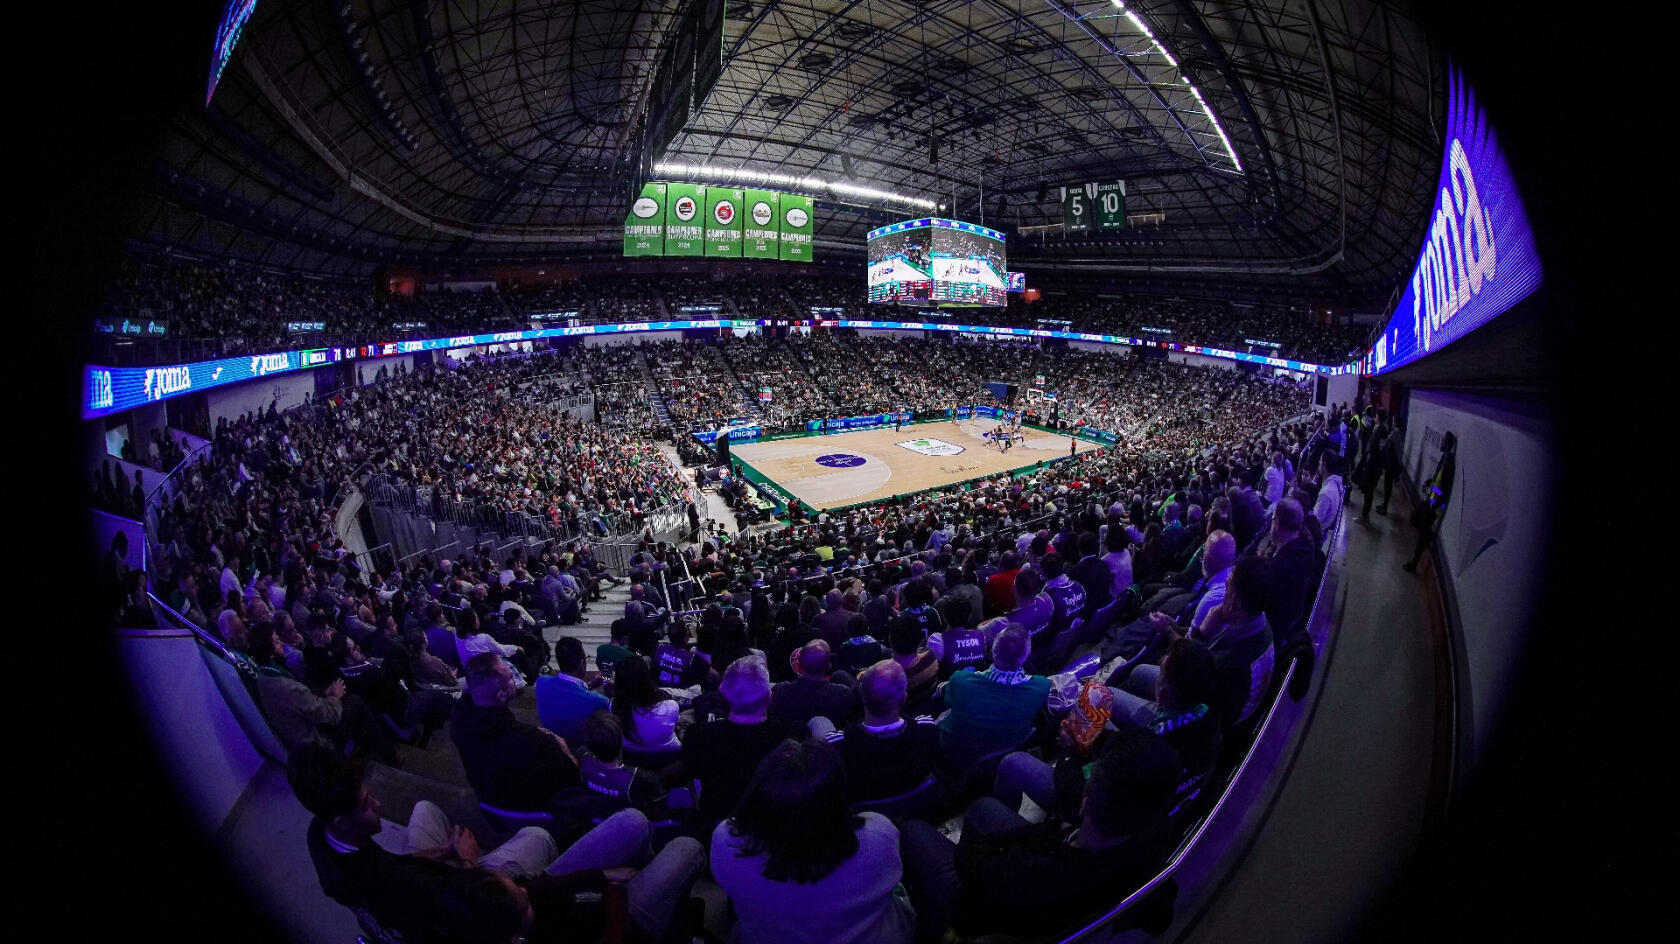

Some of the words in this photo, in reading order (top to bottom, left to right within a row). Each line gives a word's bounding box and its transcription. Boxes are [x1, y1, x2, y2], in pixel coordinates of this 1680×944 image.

[1072, 196, 1083, 216] 5
[1101, 193, 1119, 213] 10
[729, 429, 757, 439] Unicaja
[1062, 592, 1083, 606] Taylor
[955, 638, 980, 648] TYSON
